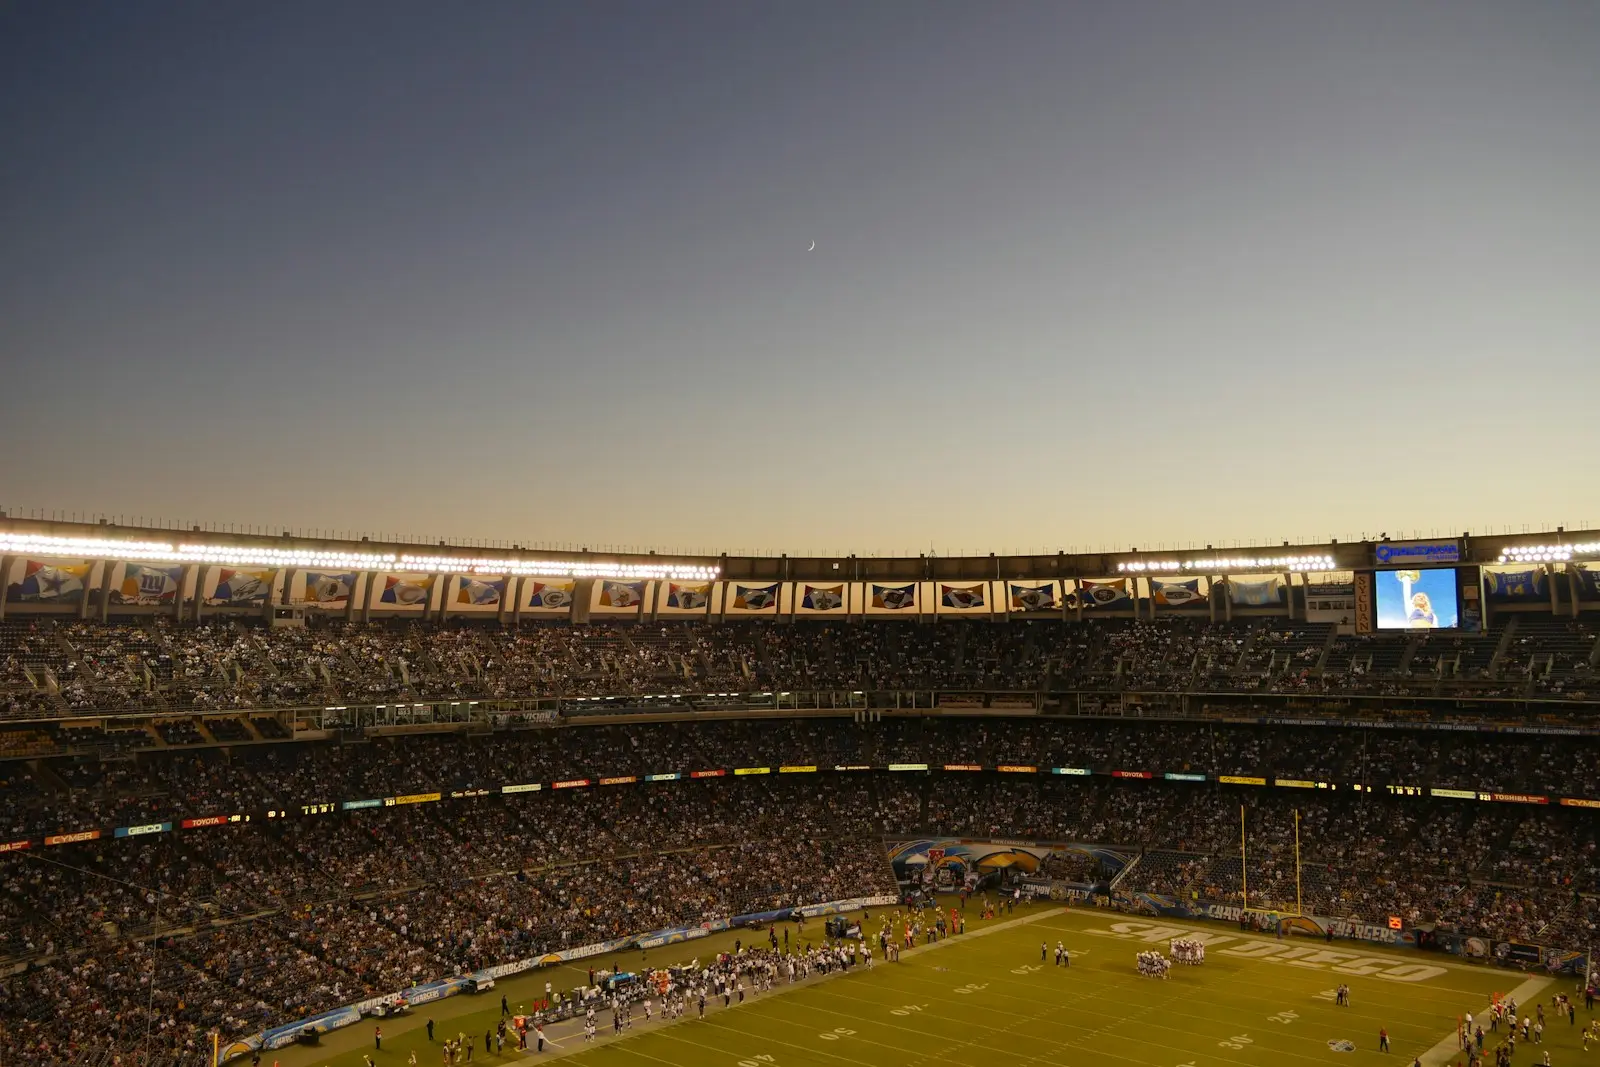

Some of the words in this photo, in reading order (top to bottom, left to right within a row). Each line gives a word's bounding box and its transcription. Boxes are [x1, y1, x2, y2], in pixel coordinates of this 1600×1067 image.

[1358, 576, 1369, 631] SYCUAN
[604, 777, 632, 785] CYMER
[1495, 794, 1528, 802] TOSHIBA
[192, 817, 219, 827] TOYOTA
[128, 824, 162, 836] GEICO
[52, 832, 93, 845] CYMER
[862, 896, 898, 905] CHARGERS
[686, 928, 709, 938] CHARGERS
[569, 943, 605, 959] CHARGERS
[1216, 940, 1448, 982] DIEGO
[494, 960, 532, 977] CHARGERS
[412, 990, 440, 1004] CHARGERS
[890, 1005, 923, 1015] 40
[1267, 1012, 1300, 1024] 20
[818, 1027, 858, 1040] 50
[1218, 1036, 1254, 1050] 30
[737, 1054, 776, 1067] 40
